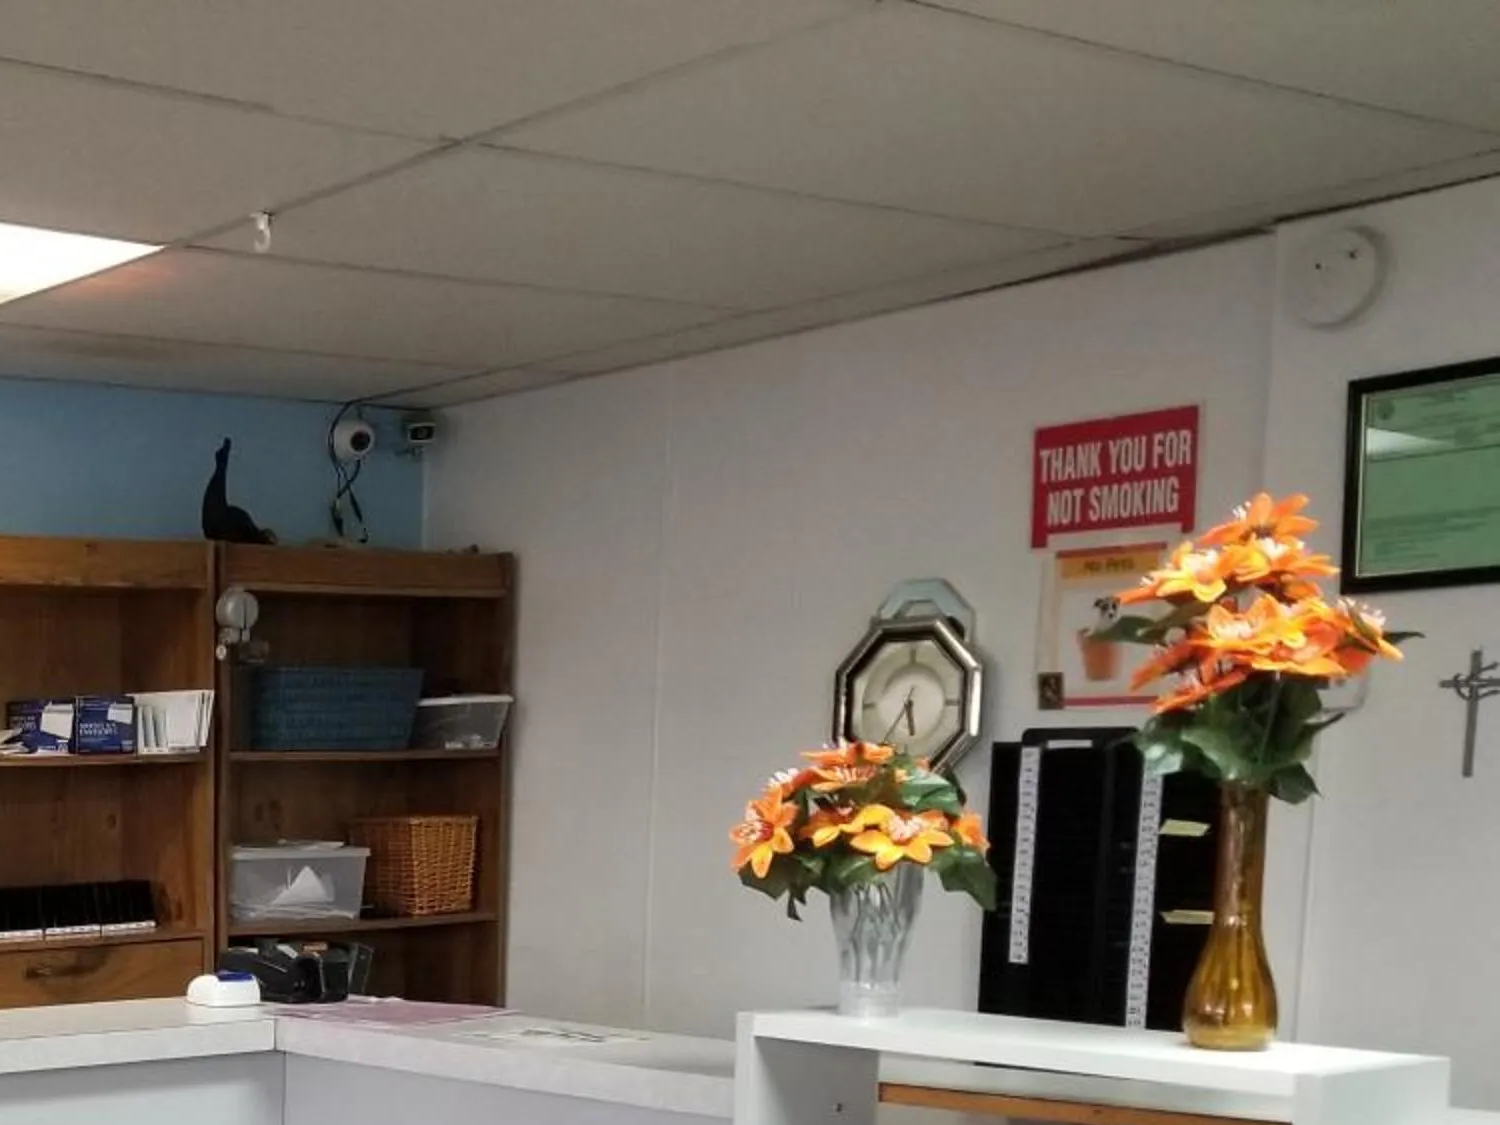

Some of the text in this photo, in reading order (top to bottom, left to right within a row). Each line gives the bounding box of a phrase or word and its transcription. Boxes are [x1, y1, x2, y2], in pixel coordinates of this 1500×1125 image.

[1040, 429, 1192, 484] THANK YOU FOR
[1047, 476, 1179, 527] NOT SMOKING
